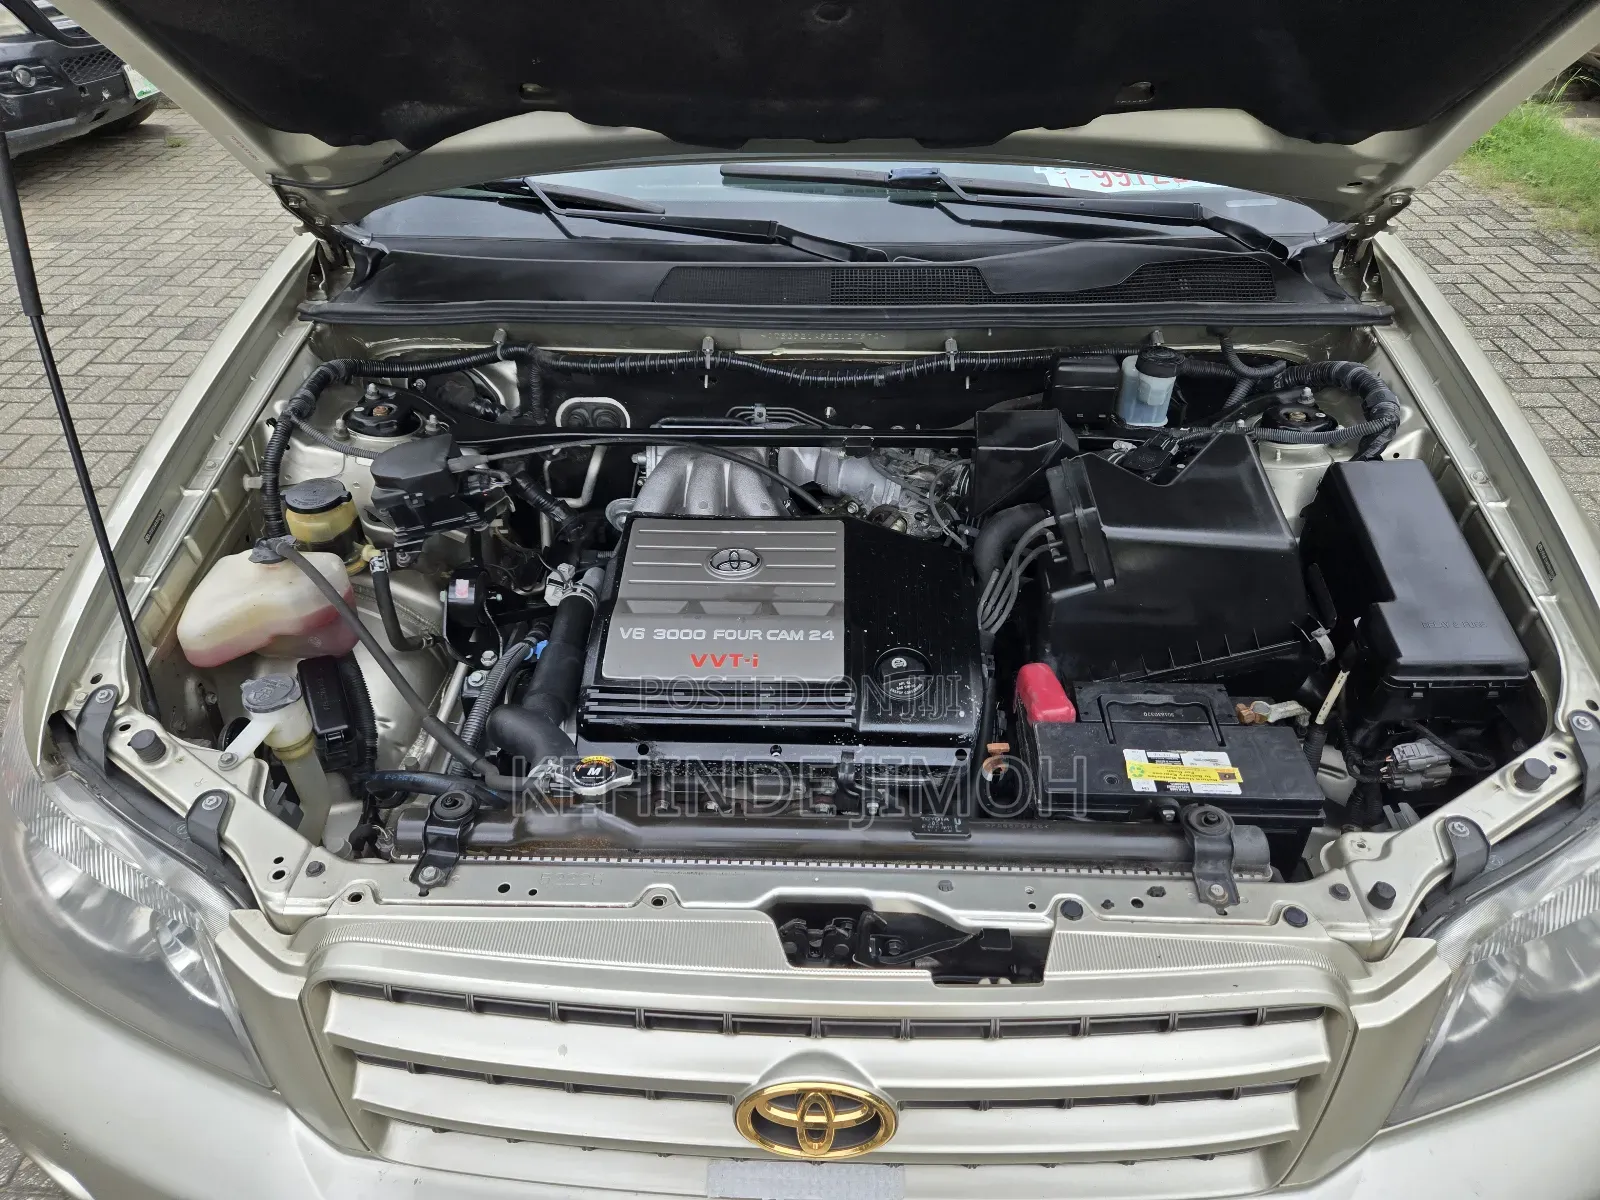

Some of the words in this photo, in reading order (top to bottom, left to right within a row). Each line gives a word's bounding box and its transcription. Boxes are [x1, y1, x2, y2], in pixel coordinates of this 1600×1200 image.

[619, 627, 646, 640] V6
[653, 627, 707, 640] 3000
[713, 628, 763, 641] FOUR
[766, 629, 804, 641] CAM
[808, 629, 835, 641] 24
[689, 653, 760, 669] VVT-i
